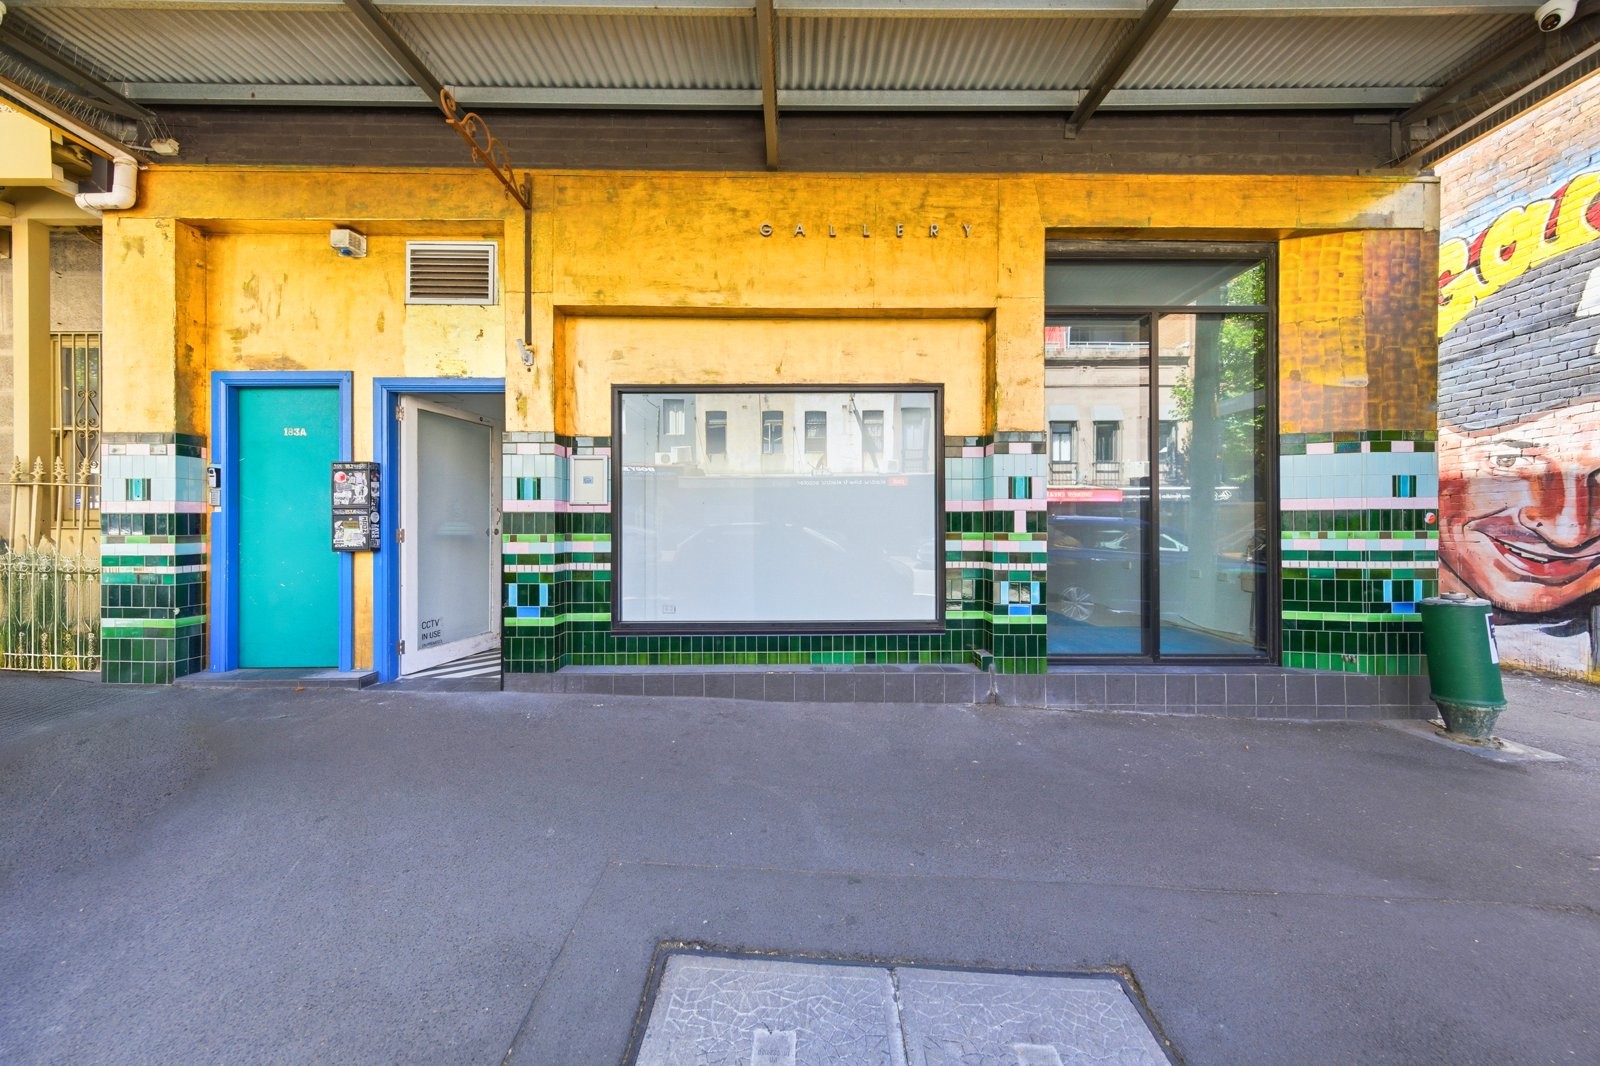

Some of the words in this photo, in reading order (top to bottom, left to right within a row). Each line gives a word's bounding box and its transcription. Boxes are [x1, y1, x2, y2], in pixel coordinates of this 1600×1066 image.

[759, 223, 972, 238] GALLERY
[283, 427, 307, 437] 183A
[421, 619, 440, 630] CCTV
[429, 630, 441, 639] USE
